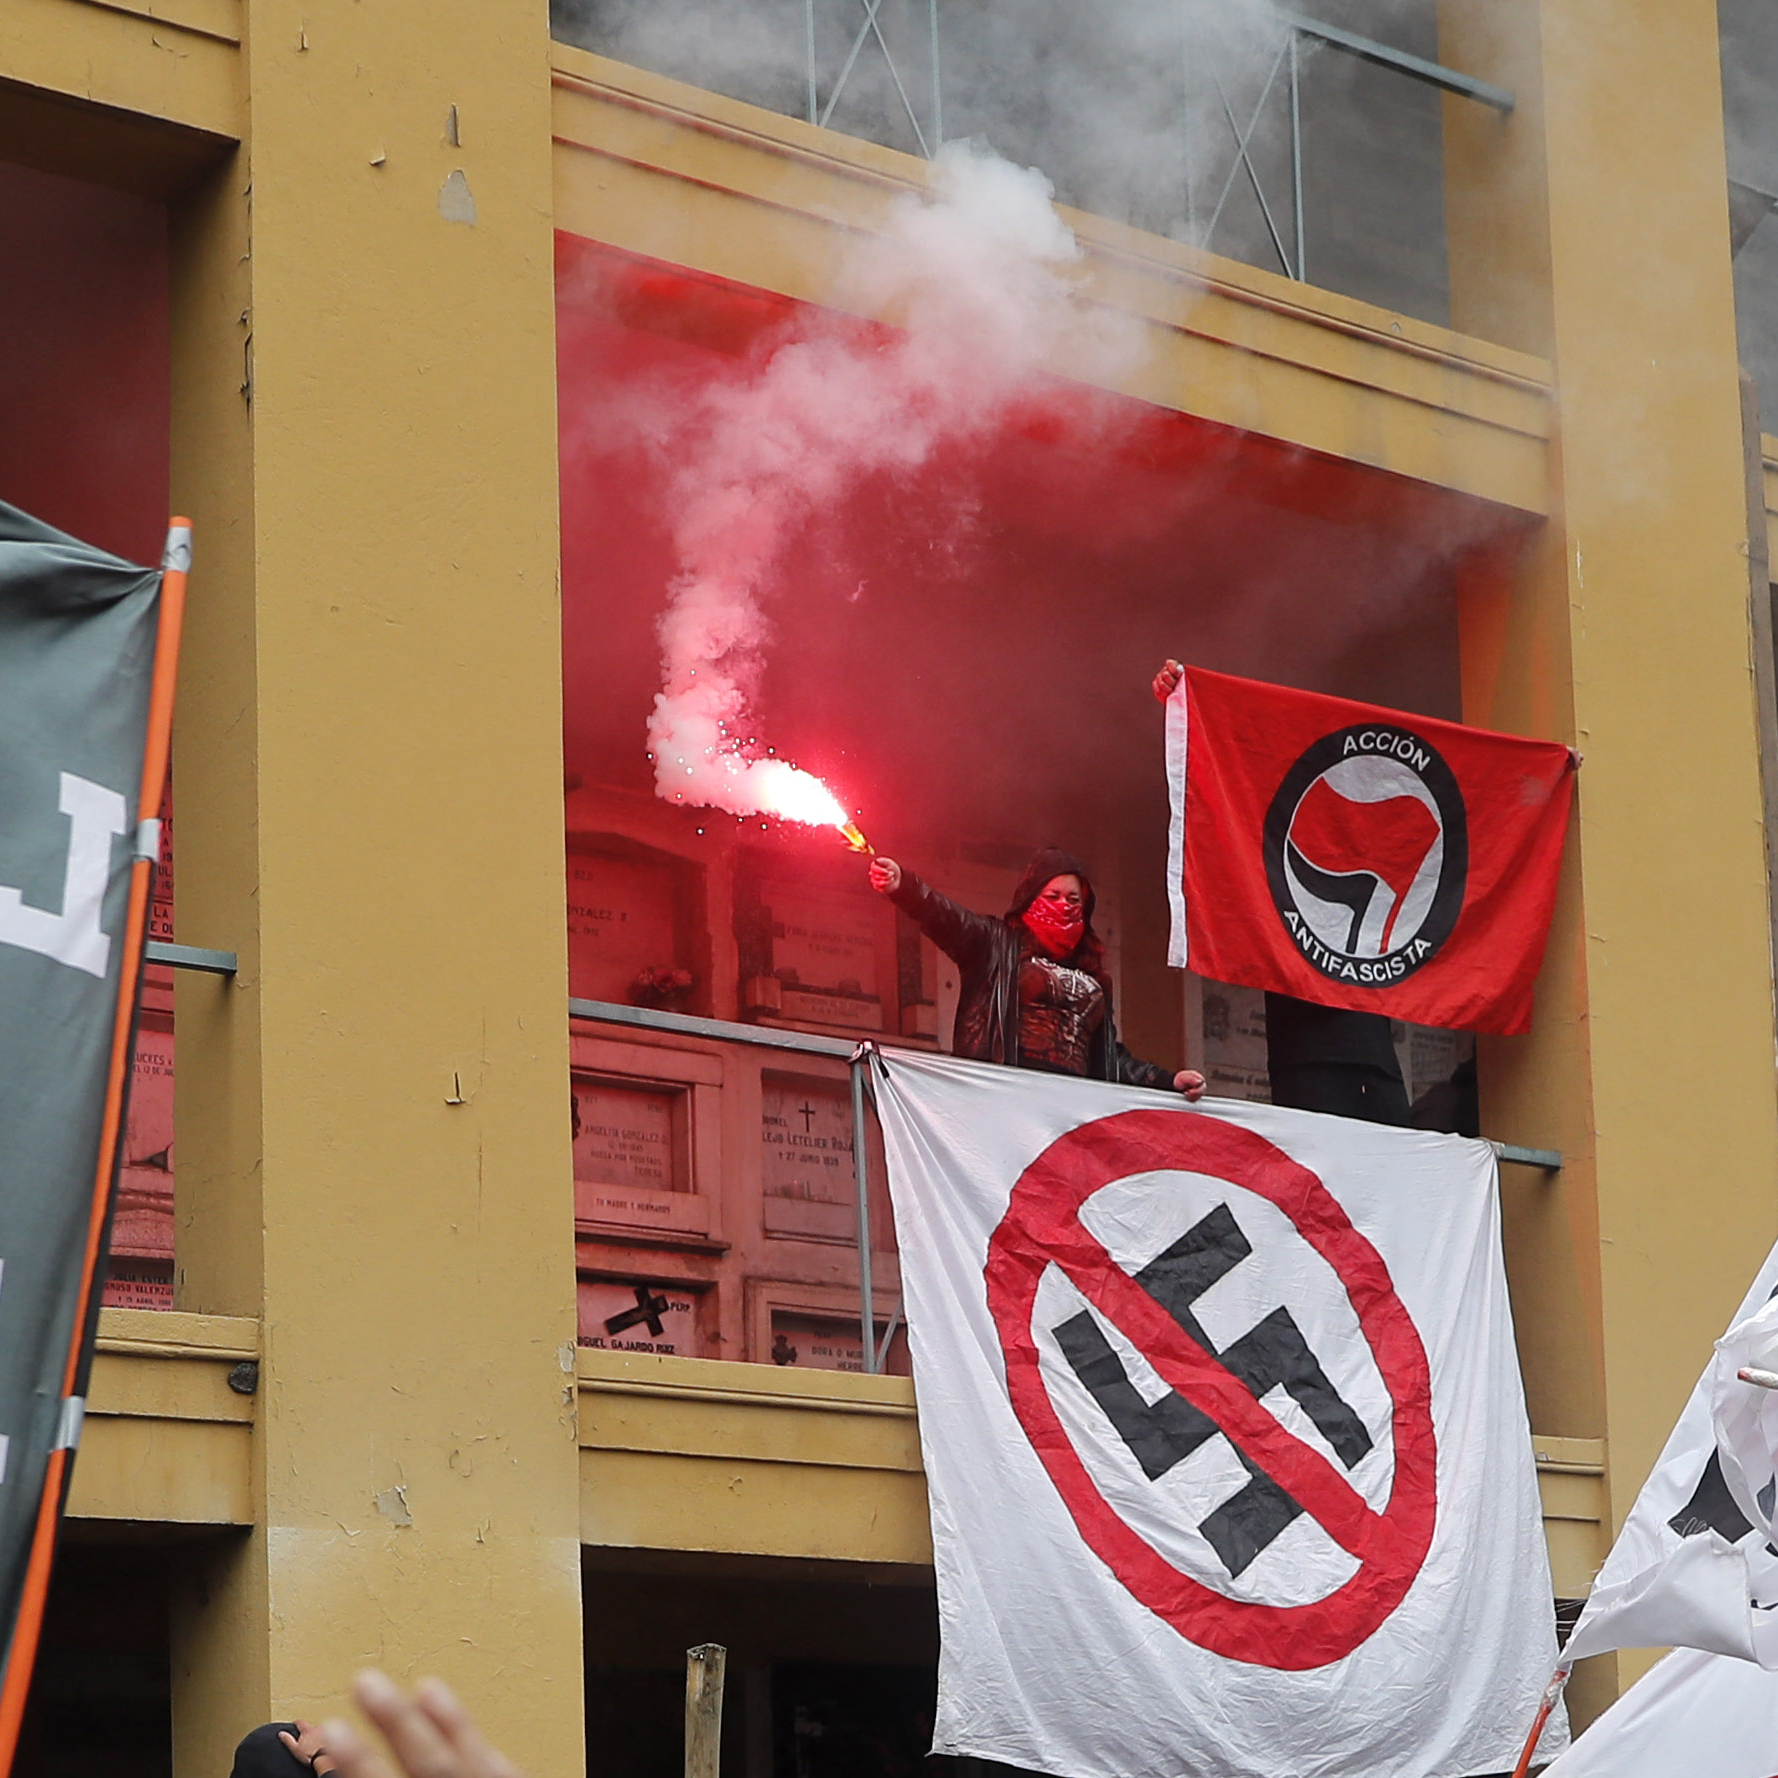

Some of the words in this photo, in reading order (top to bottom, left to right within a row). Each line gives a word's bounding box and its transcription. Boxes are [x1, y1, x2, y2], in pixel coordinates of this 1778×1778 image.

[1342, 729, 1432, 773] ACCIÓN
[1284, 909, 1432, 983] ANTIFASCISTA
[831, 1136, 853, 1152] ROJA
